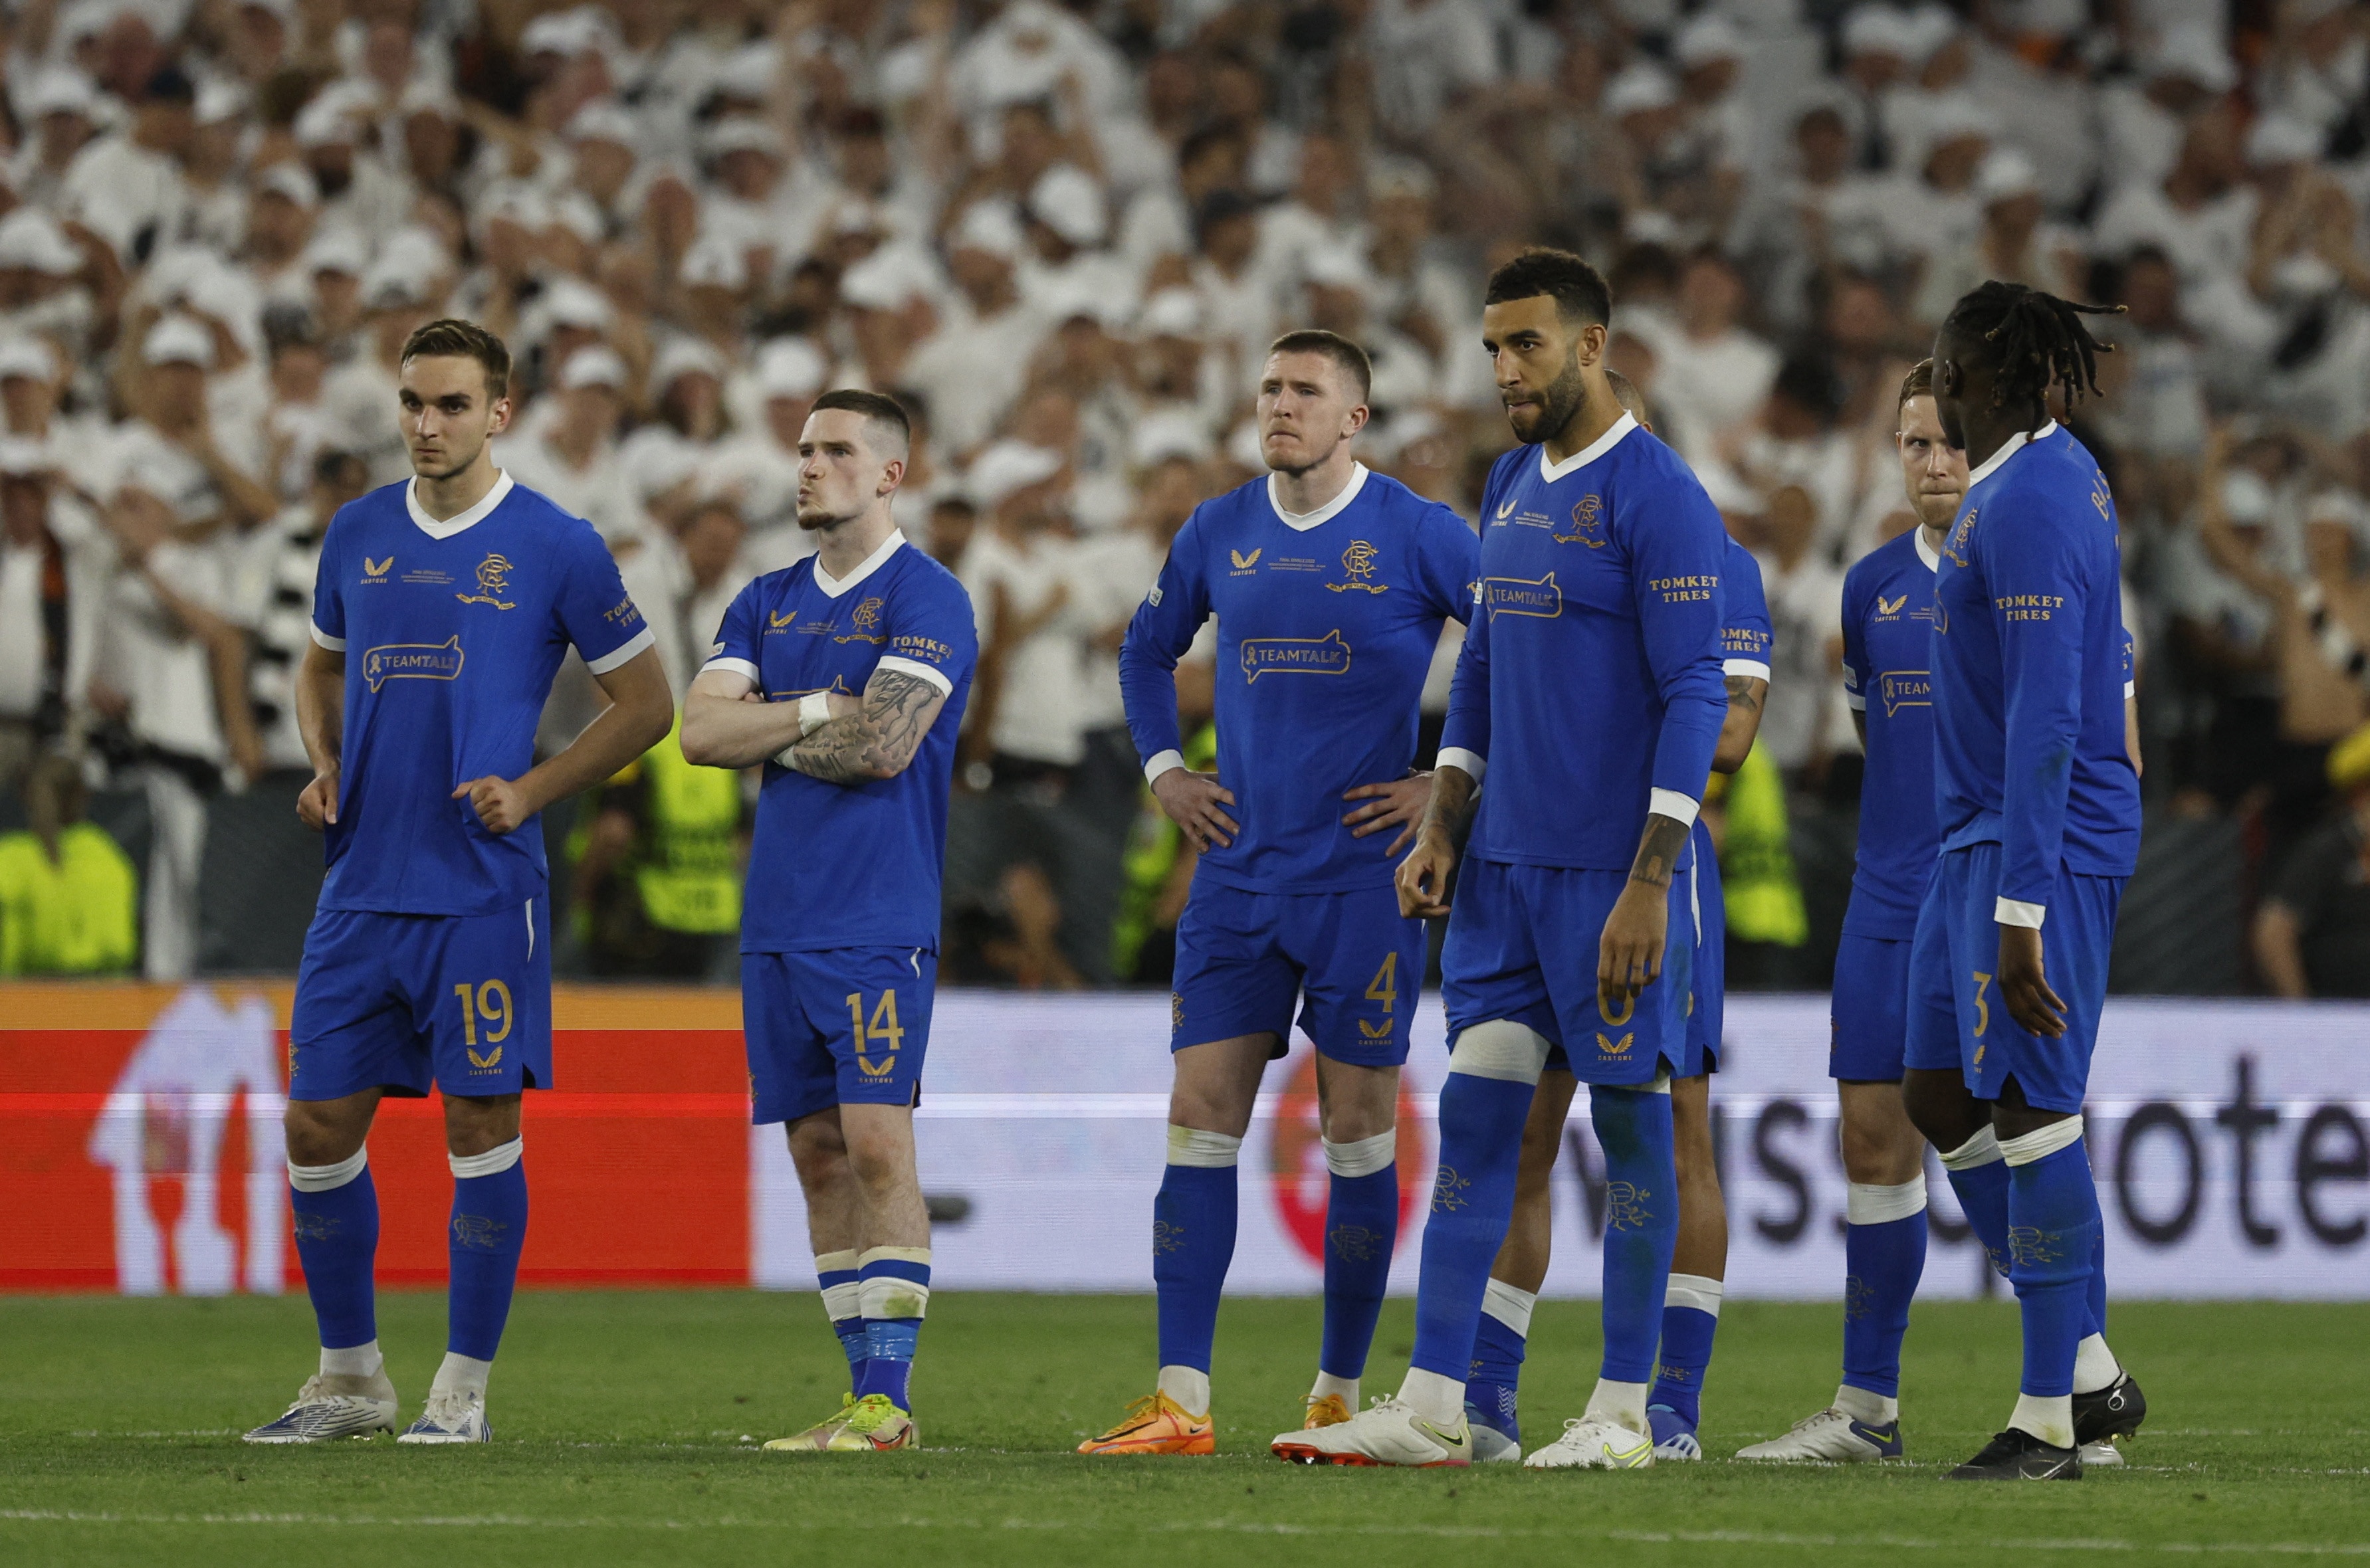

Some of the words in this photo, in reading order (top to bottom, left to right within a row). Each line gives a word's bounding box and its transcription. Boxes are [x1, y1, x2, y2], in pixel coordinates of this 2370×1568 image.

[1649, 575, 1718, 591] TOMKET
[1495, 589, 1553, 607] TEAMTALK
[1663, 589, 1711, 603] TIRES
[1995, 595, 2064, 609] TOMKET
[2006, 609, 2050, 621] TIRES
[1259, 648, 1341, 664] TEAMTALK
[1896, 682, 1931, 695] TEAM
[1364, 951, 1398, 1013] 4
[454, 978, 513, 1046] 19
[1973, 971, 1993, 1038] 3
[845, 989, 905, 1053] 14
